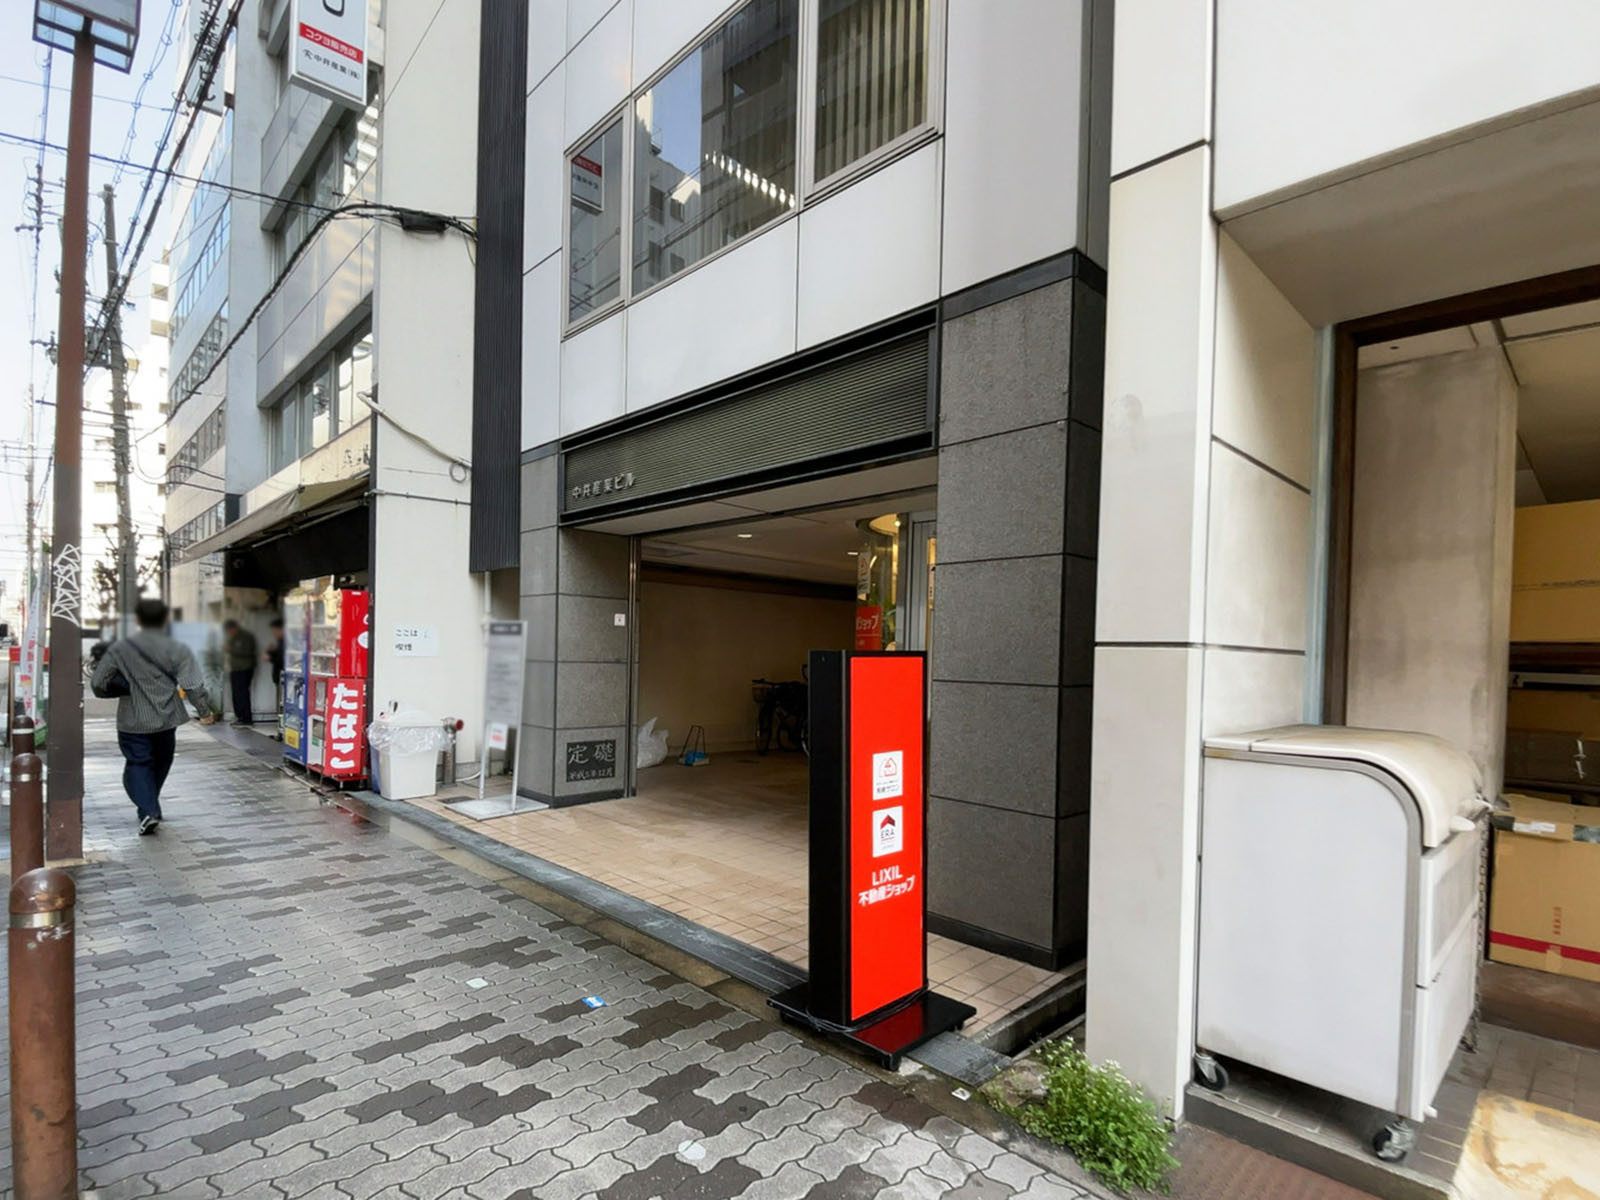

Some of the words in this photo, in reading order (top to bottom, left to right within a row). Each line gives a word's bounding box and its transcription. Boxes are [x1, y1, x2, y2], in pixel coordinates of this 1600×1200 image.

[880, 829, 895, 839] ERA
[872, 865, 903, 886] LIXIL
[858, 875, 915, 907] 不動産ショップ
